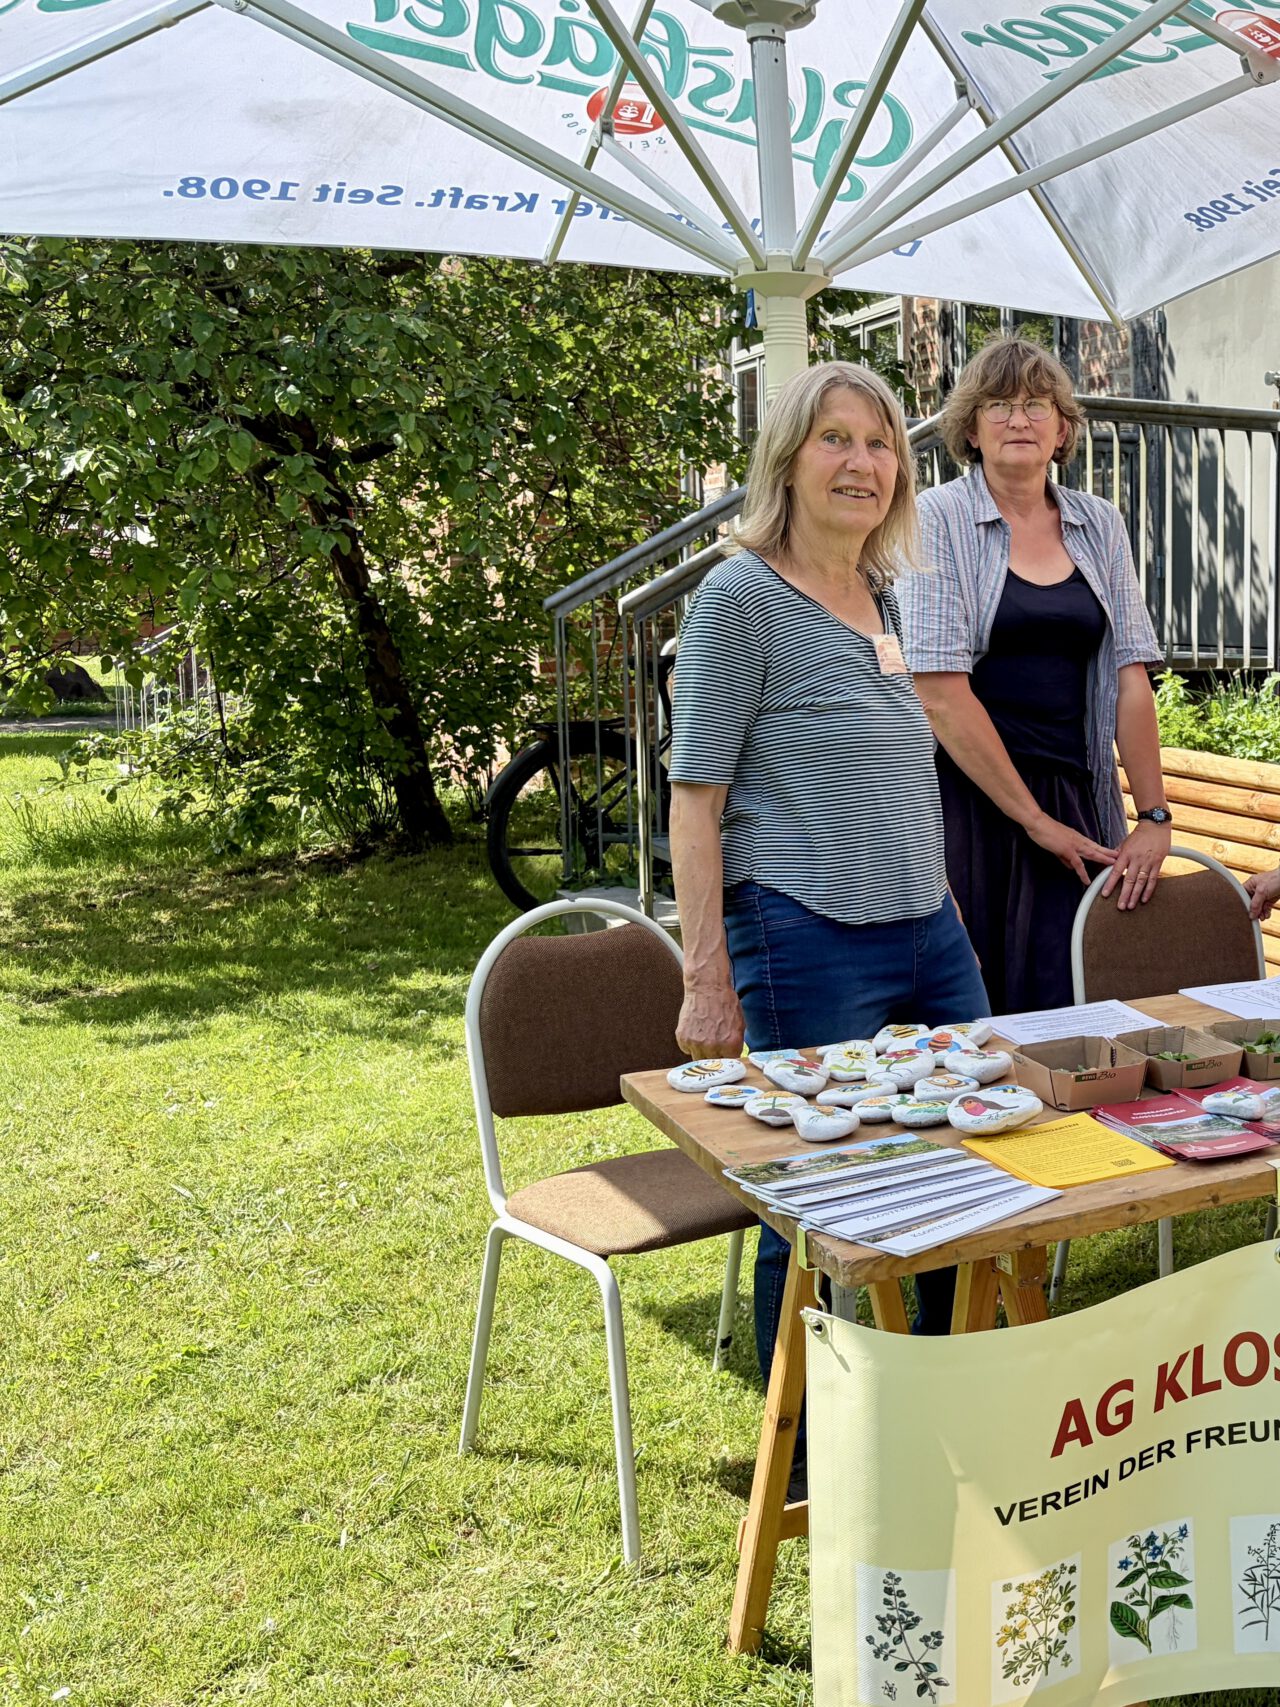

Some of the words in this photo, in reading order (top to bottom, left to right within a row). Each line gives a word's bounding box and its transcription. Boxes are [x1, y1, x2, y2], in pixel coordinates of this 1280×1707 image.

[1050, 1378, 1134, 1458] AG
[994, 1468, 1109, 1526] VEREIN
[1118, 1438, 1176, 1482] DER
